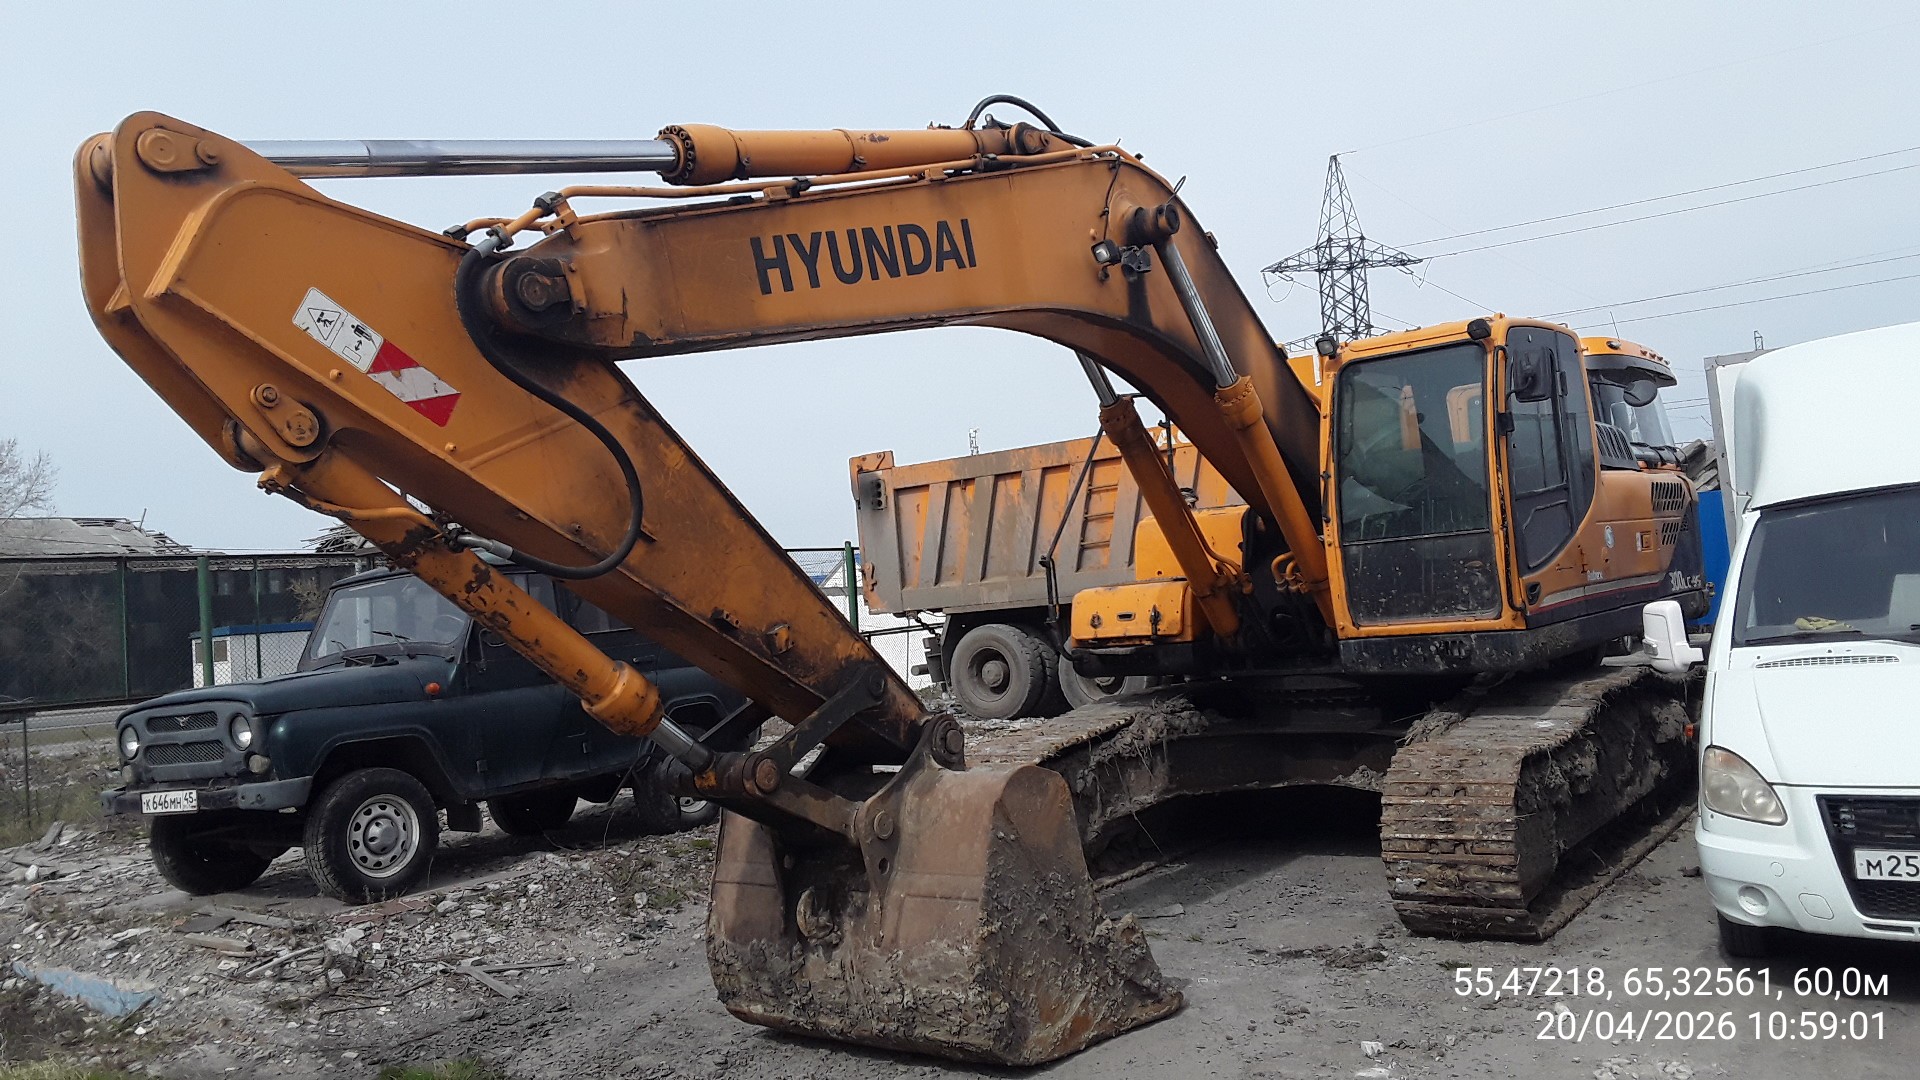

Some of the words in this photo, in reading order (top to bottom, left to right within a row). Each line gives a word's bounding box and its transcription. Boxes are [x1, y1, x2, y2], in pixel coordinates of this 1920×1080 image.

[750, 218, 977, 295] HYUNDAI
[145, 794, 182, 811] К646МН
[184, 791, 194, 804] 45
[1865, 855, 1920, 878] М25
